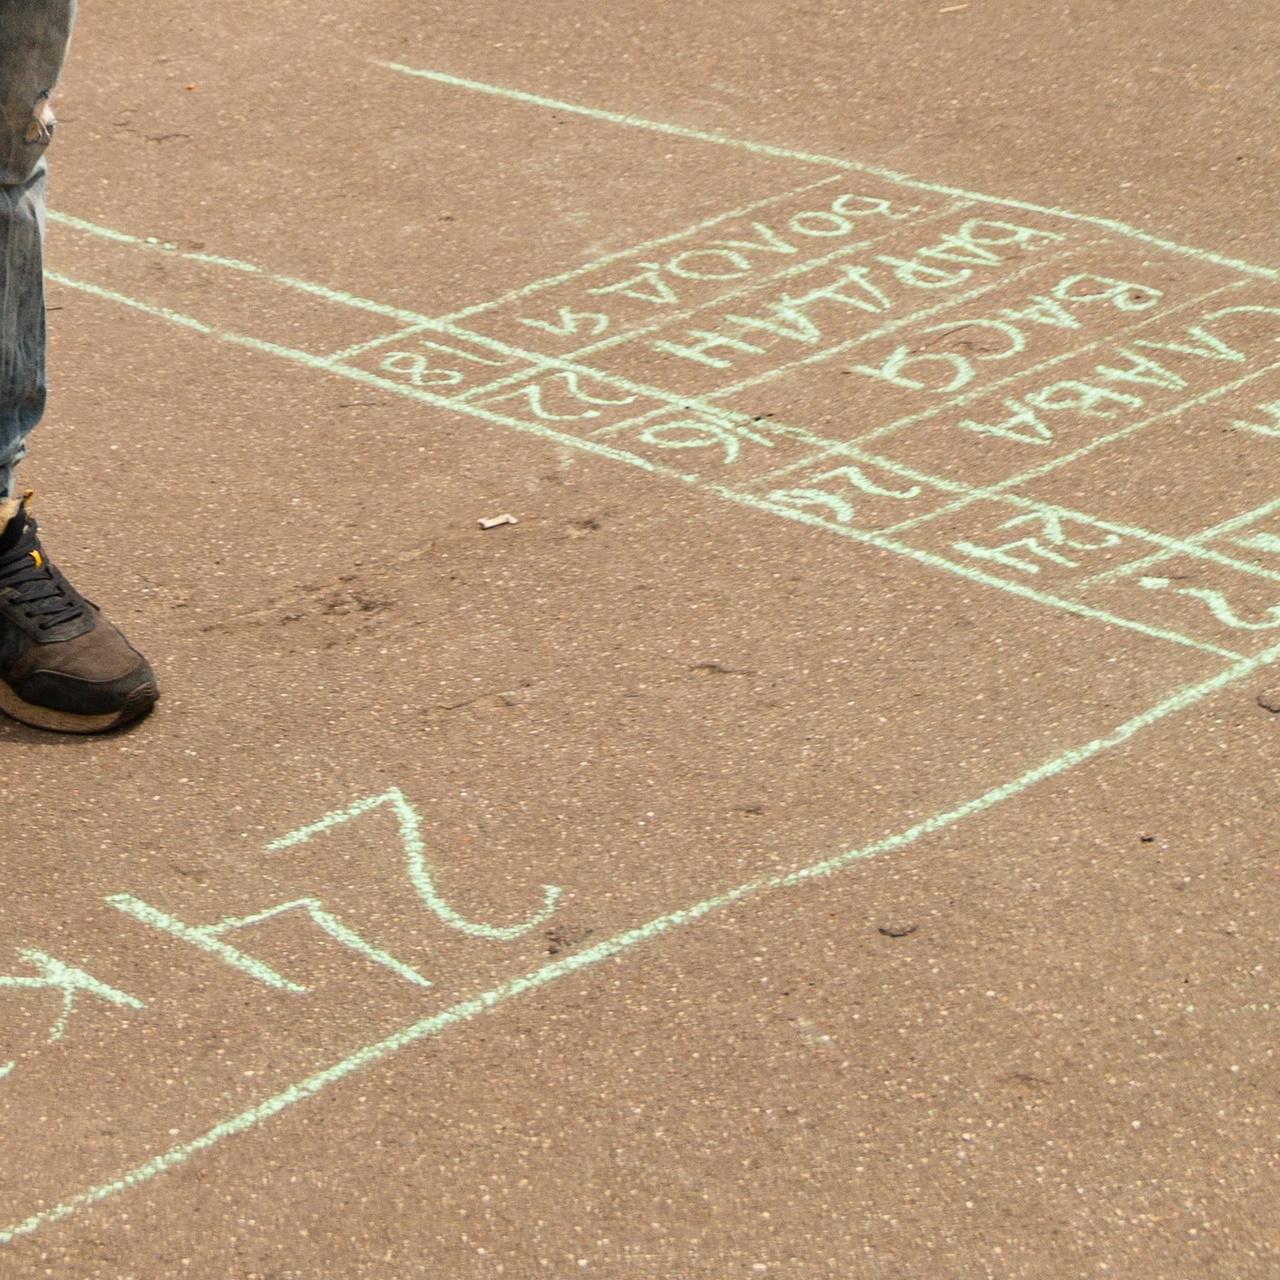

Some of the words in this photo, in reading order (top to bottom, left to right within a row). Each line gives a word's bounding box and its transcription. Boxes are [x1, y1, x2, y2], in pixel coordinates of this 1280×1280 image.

[518, 193, 920, 337] ВОЛОДЯ
[653, 218, 1066, 369] ВАРДАН
[379, 340, 505, 386] 18
[848, 273, 1163, 394] ВАСЯ
[958, 305, 1280, 445] СЛАВА
[484, 370, 636, 421] 22
[638, 406, 774, 464] 16
[952, 510, 1121, 573] 24
[104, 787, 564, 994] 24
